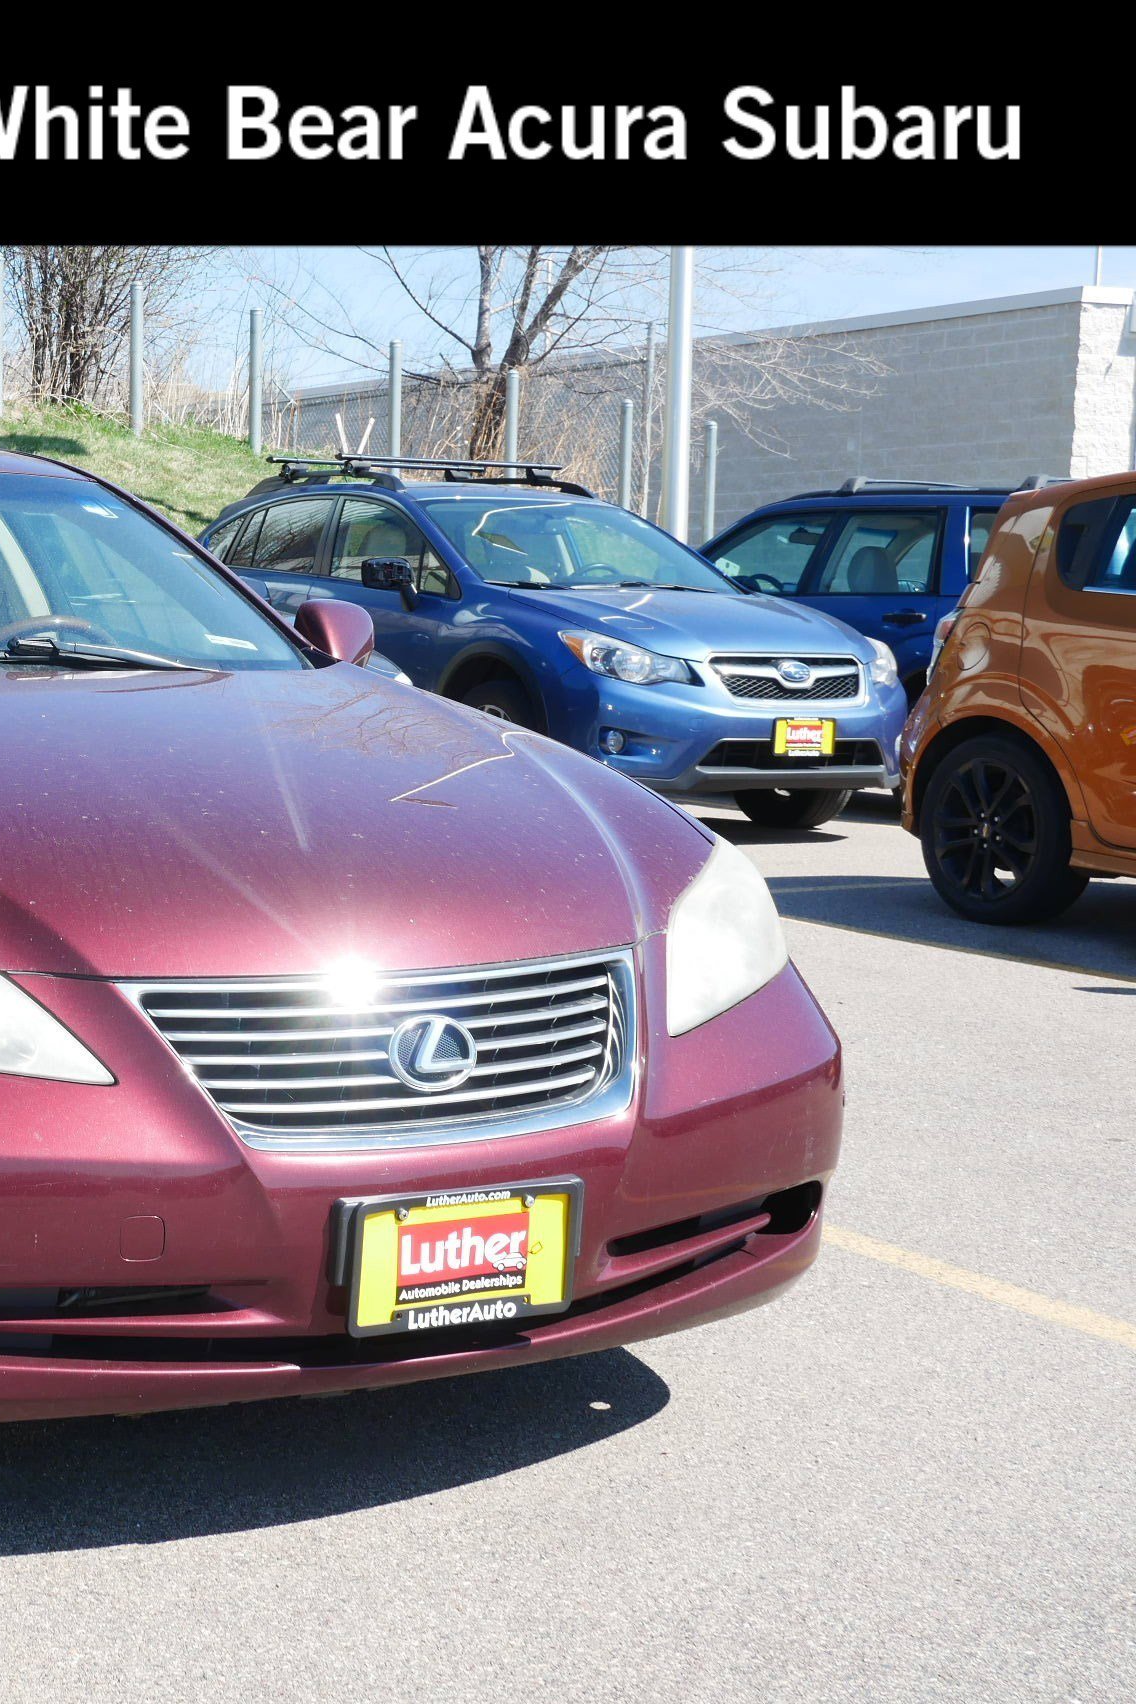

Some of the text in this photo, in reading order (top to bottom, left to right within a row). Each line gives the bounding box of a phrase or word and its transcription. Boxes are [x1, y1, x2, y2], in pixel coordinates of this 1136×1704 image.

[425, 1189, 511, 1208] LutherAuto.com
[400, 1227, 527, 1276] Luther
[399, 1274, 523, 1301] Automobile Dealerships
[408, 1300, 517, 1330] LutherAuto
